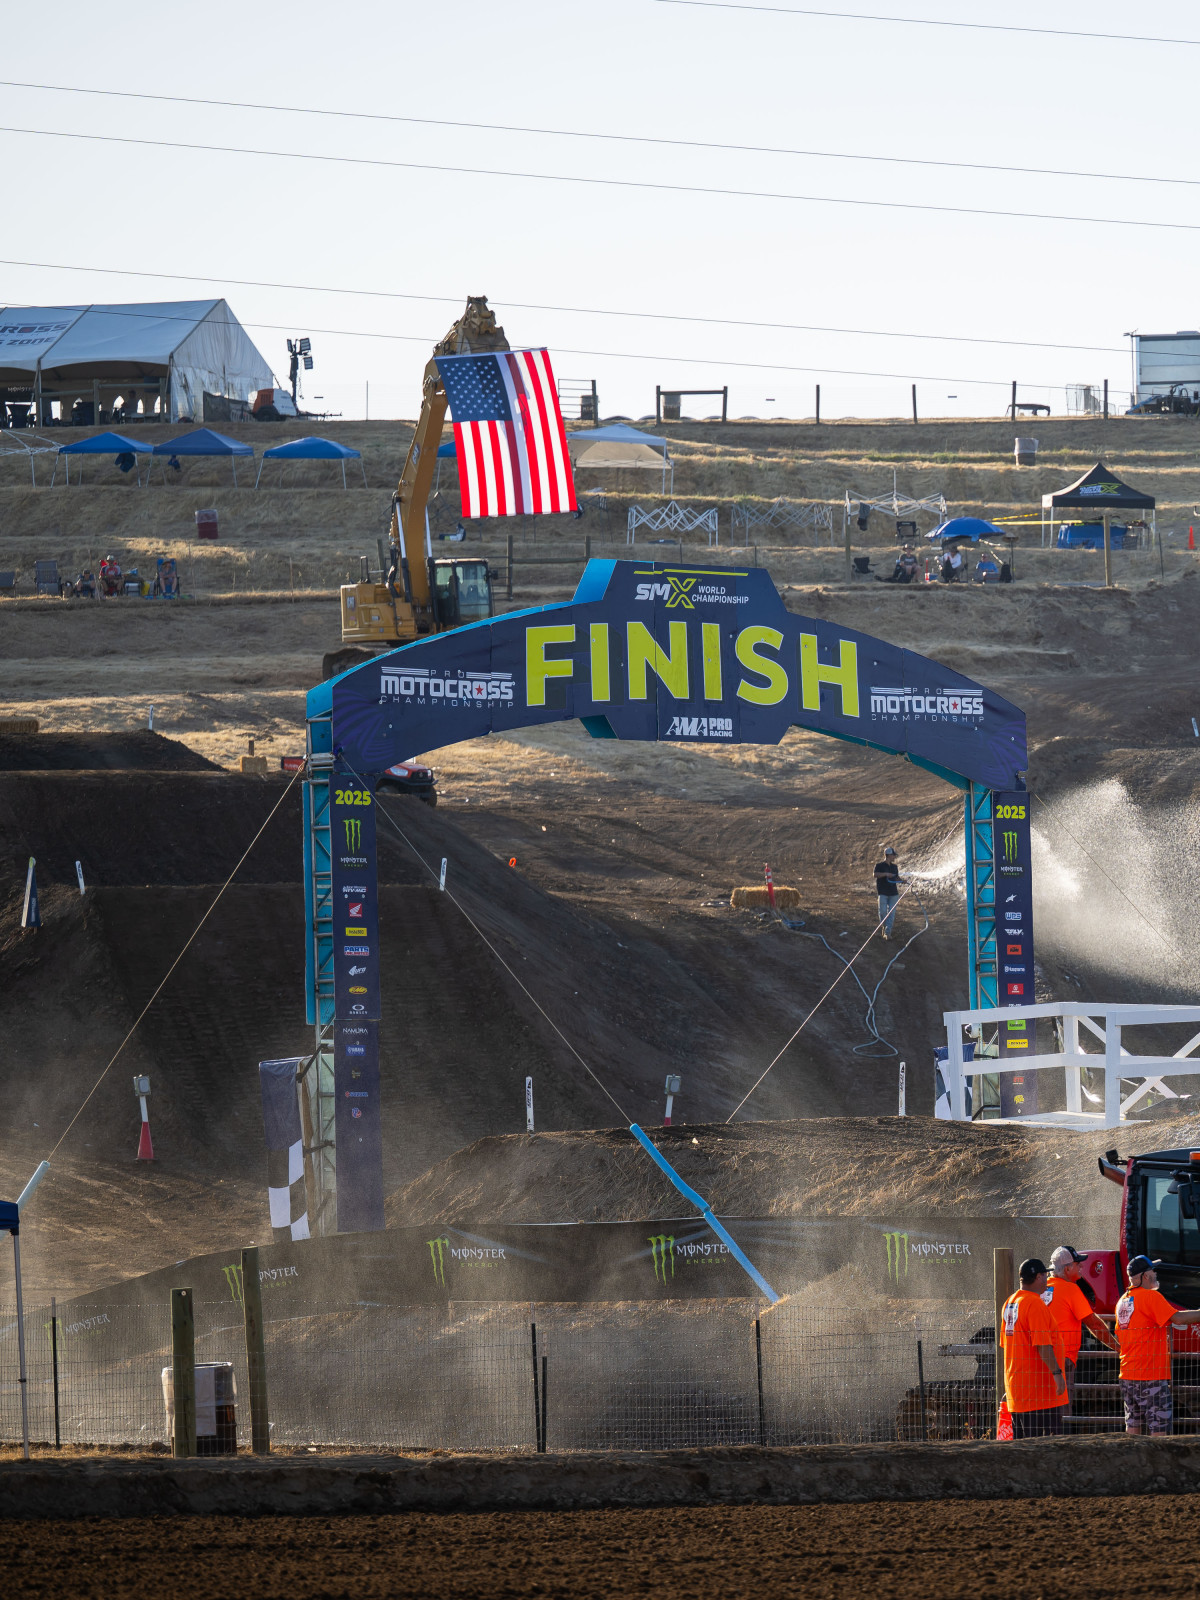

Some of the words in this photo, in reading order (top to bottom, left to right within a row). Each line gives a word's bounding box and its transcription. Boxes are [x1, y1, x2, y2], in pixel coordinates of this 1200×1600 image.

[634, 576, 697, 609] SMX
[698, 585, 726, 594] WORLD
[691, 594, 749, 604] CHAMPIONSHIP
[430, 669, 465, 679] PRO
[525, 620, 860, 718] FINISH
[380, 675, 513, 700] MOTOCROSS
[912, 687, 943, 695] PRO
[380, 695, 514, 708] CHAMPIONSHIP
[870, 695, 984, 715] MOTOCROSS
[709, 718, 733, 731] PRO
[871, 714, 984, 722] CHAMPIONSHIP
[664, 716, 708, 736] AMA
[335, 789, 371, 806] 2025
[995, 804, 1026, 820] 2025
[340, 856, 368, 864] MONSTER
[1000, 865, 1023, 873] MONSTER
[342, 1027, 369, 1035] NAMURA
[451, 1246, 507, 1260] MONSTER
[911, 1242, 972, 1256] MONSTER
[258, 1266, 299, 1282] ONSTER
[65, 1313, 111, 1335] MONSTER
